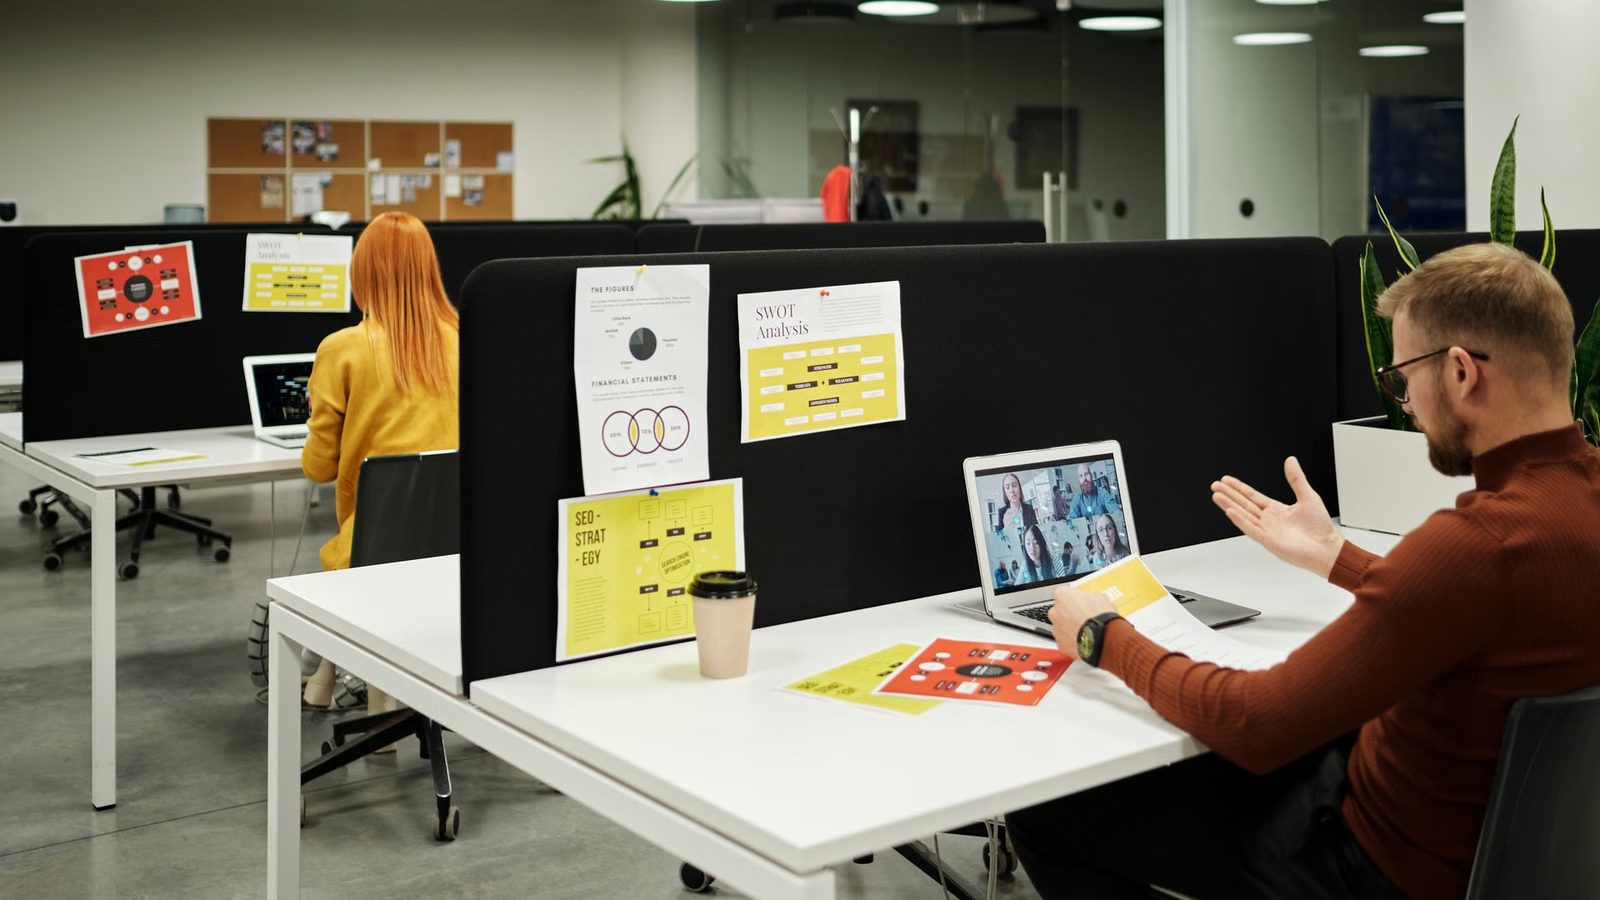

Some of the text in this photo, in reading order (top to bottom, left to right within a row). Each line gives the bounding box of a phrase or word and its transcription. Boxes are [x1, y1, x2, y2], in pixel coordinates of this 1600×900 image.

[756, 304, 795, 321] SWOT
[756, 320, 809, 340] Analysis
[591, 374, 678, 387] FINANCIAL STATEMENTS
[575, 510, 594, 526] SEO
[575, 528, 607, 547] STRAT
[582, 549, 601, 566] EGY
[660, 556, 676, 568] SEARCH
